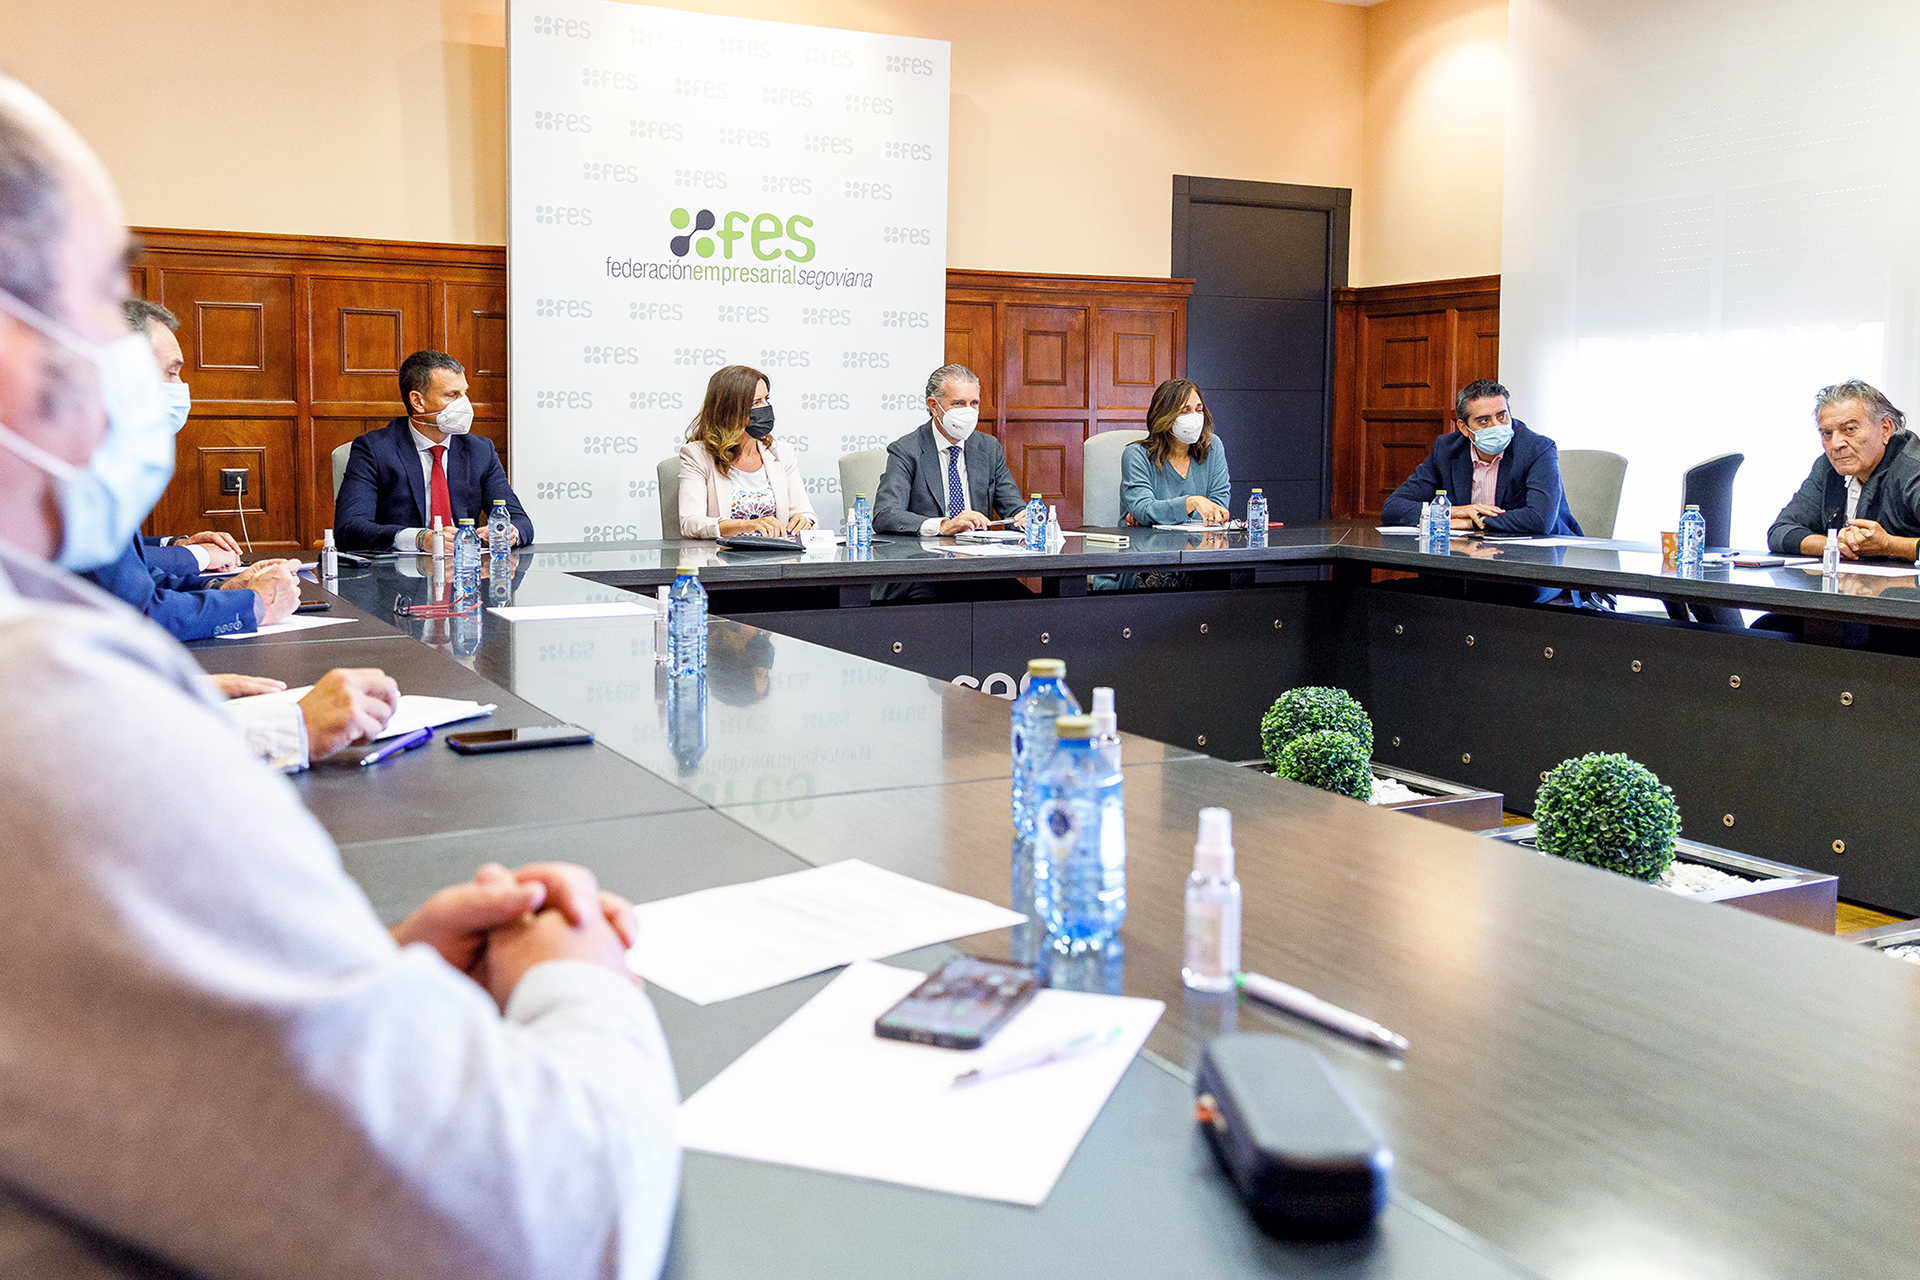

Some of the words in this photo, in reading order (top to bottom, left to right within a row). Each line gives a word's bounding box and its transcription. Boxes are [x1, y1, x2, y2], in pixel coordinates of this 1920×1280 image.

[552, 17, 592, 40] fes
[647, 29, 683, 50] fes
[736, 38, 771, 59] fes
[822, 48, 854, 68] fes
[901, 57, 933, 76] fes
[601, 70, 638, 91] fes
[692, 79, 728, 100] fes
[779, 88, 813, 108] fes
[861, 96, 894, 115] fes
[553, 112, 592, 134] fes
[648, 120, 684, 141] fes
[736, 128, 771, 148] fes
[820, 135, 853, 155] fes
[900, 142, 932, 161] fes
[601, 164, 639, 184] fes
[692, 170, 727, 189] fes
[778, 176, 812, 196] fes
[860, 182, 893, 201] fes
[555, 207, 593, 227] fes
[716, 211, 816, 263] fes
[899, 227, 931, 246] fes
[555, 299, 593, 318] fes
[648, 303, 684, 321] fes
[736, 306, 770, 324] fes
[819, 309, 851, 326] fes
[897, 311, 929, 329] fes
[602, 347, 639, 365] fes
[692, 348, 727, 366] fes
[778, 350, 810, 368] fes
[857, 352, 890, 369] fes
[555, 391, 593, 410] fes
[648, 392, 683, 410] fes
[818, 393, 850, 410] fes
[896, 394, 926, 410] fes
[602, 436, 638, 455] fes
[555, 481, 593, 499] fes
[816, 477, 842, 494] fe
[600, 524, 638, 541] fes
